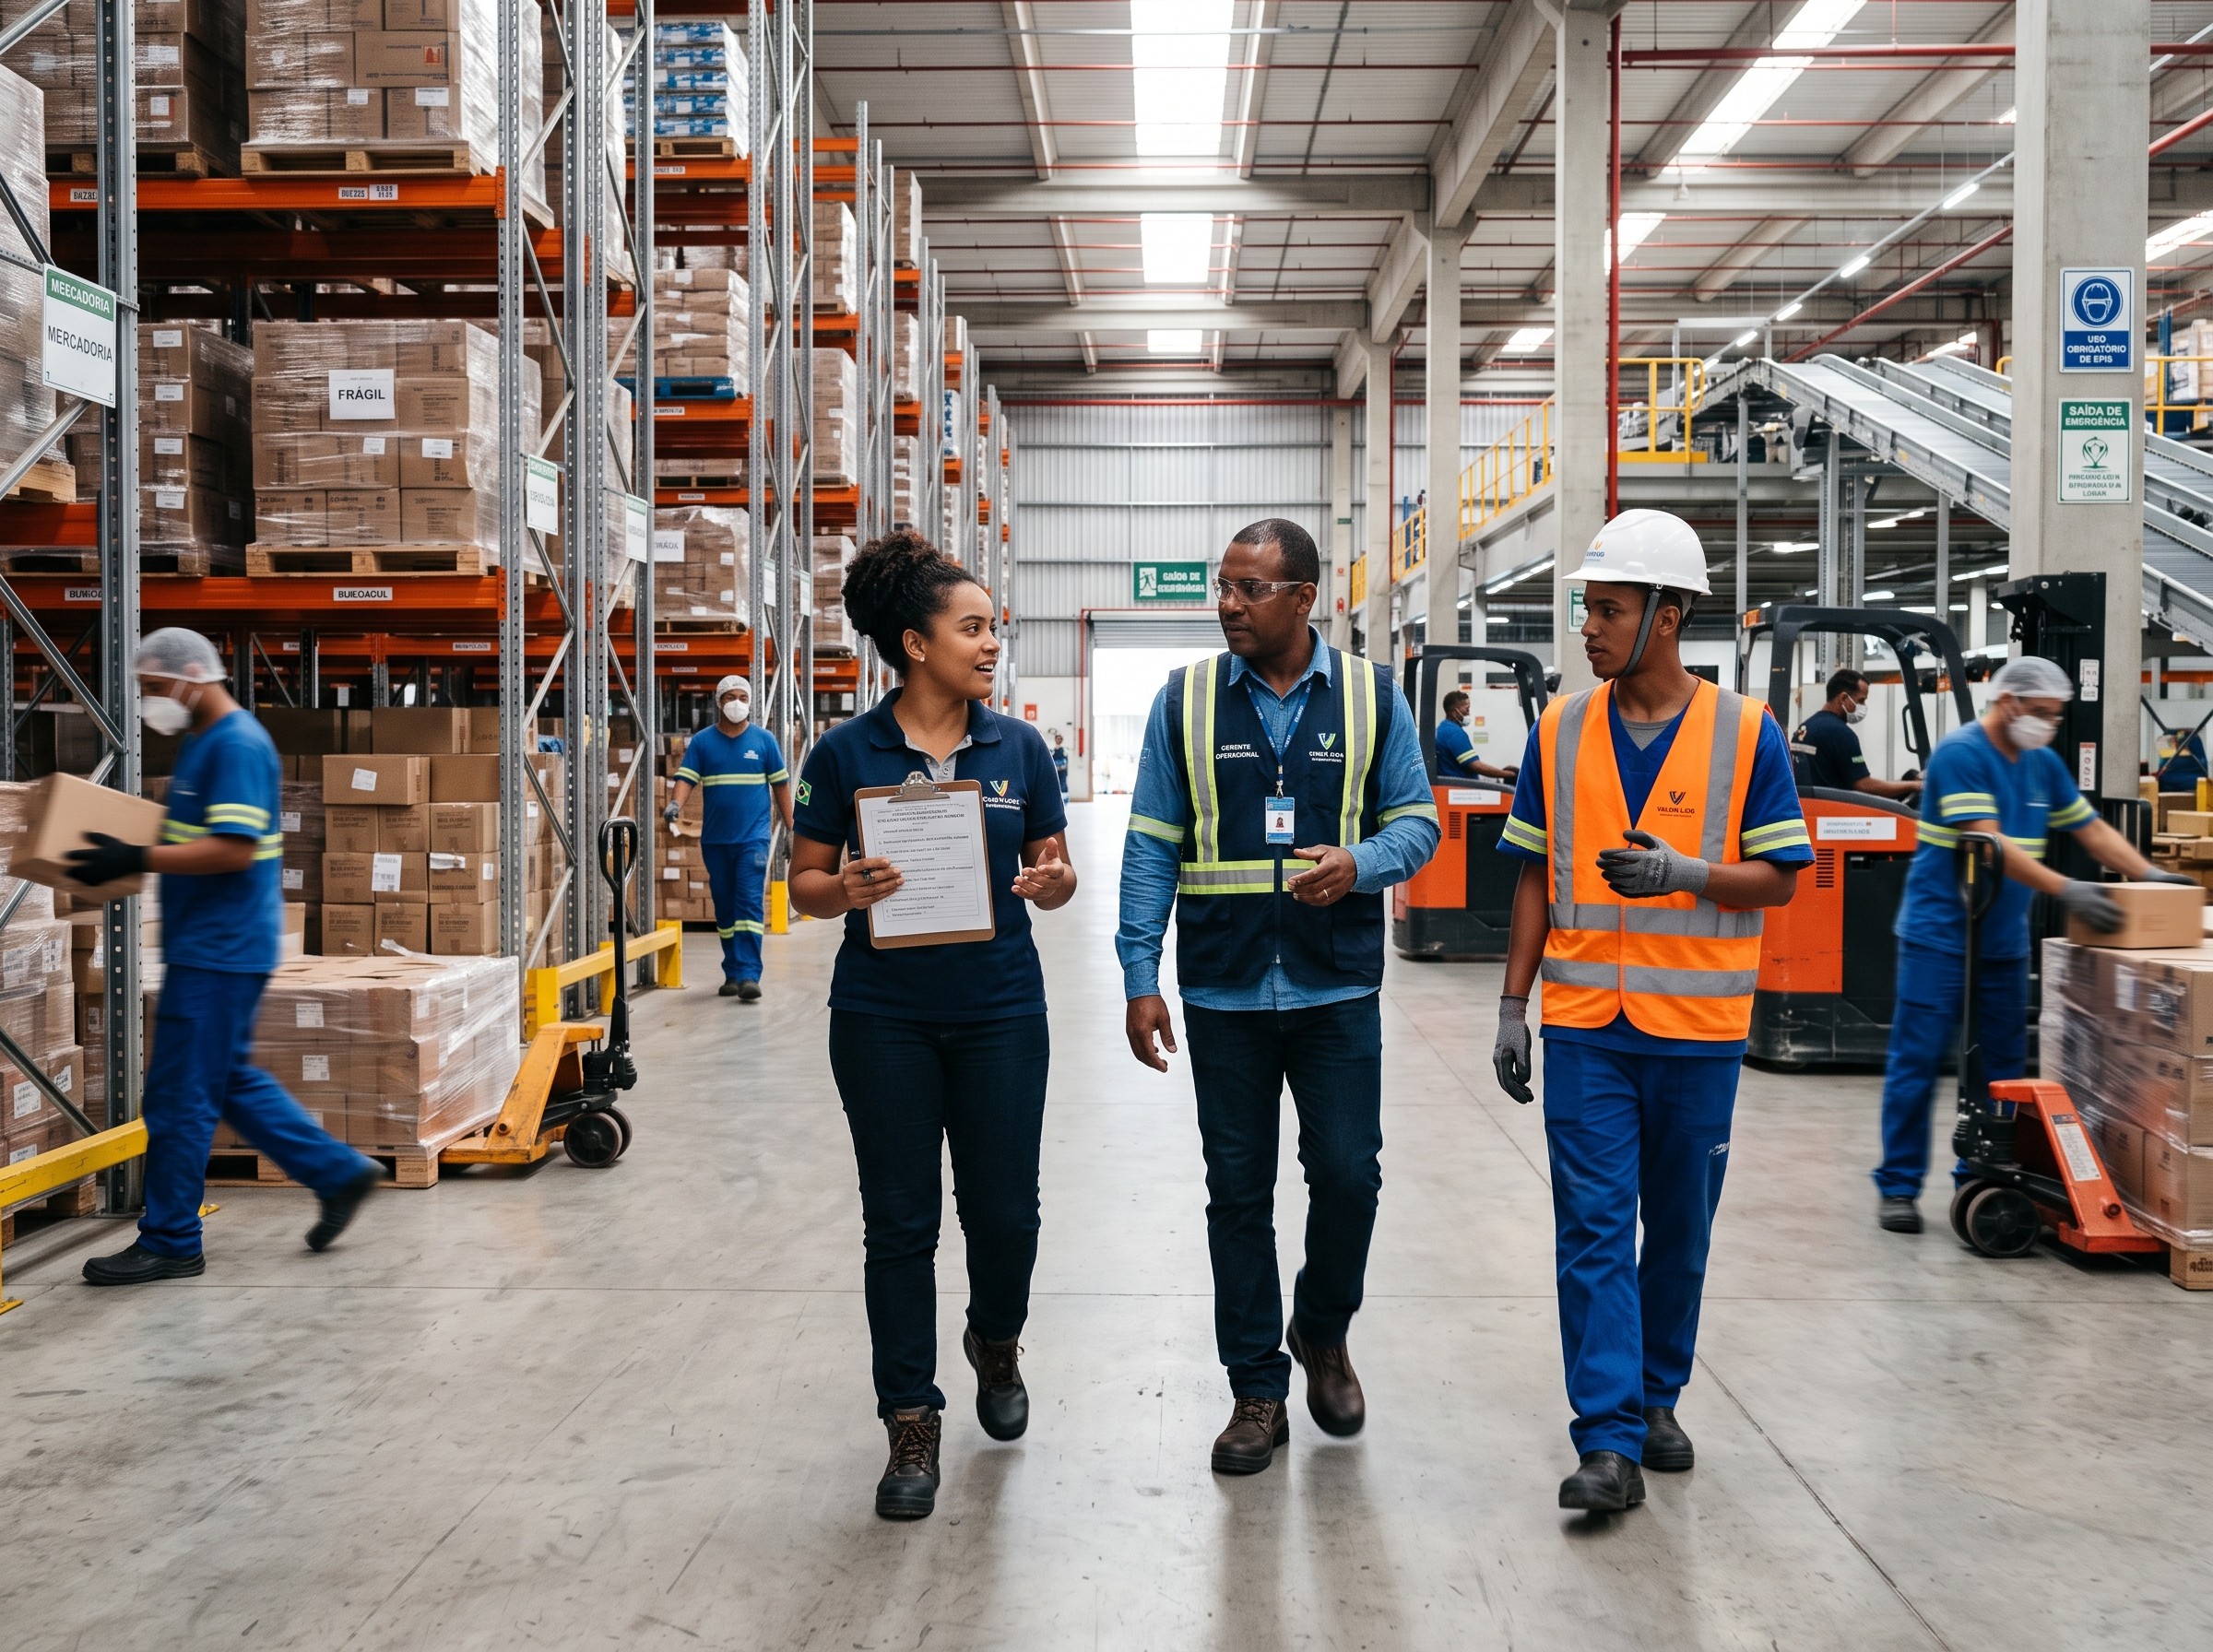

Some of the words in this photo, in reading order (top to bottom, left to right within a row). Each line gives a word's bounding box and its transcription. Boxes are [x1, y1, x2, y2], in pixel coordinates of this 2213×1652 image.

[48, 324, 112, 362] MERCADORIA
[2079, 355, 2092, 363] DE
[2093, 355, 2113, 363] EPIS
[337, 385, 385, 400] FRÁGIL
[2068, 404, 2104, 416] SAÍDA
[2106, 406, 2123, 416] DE
